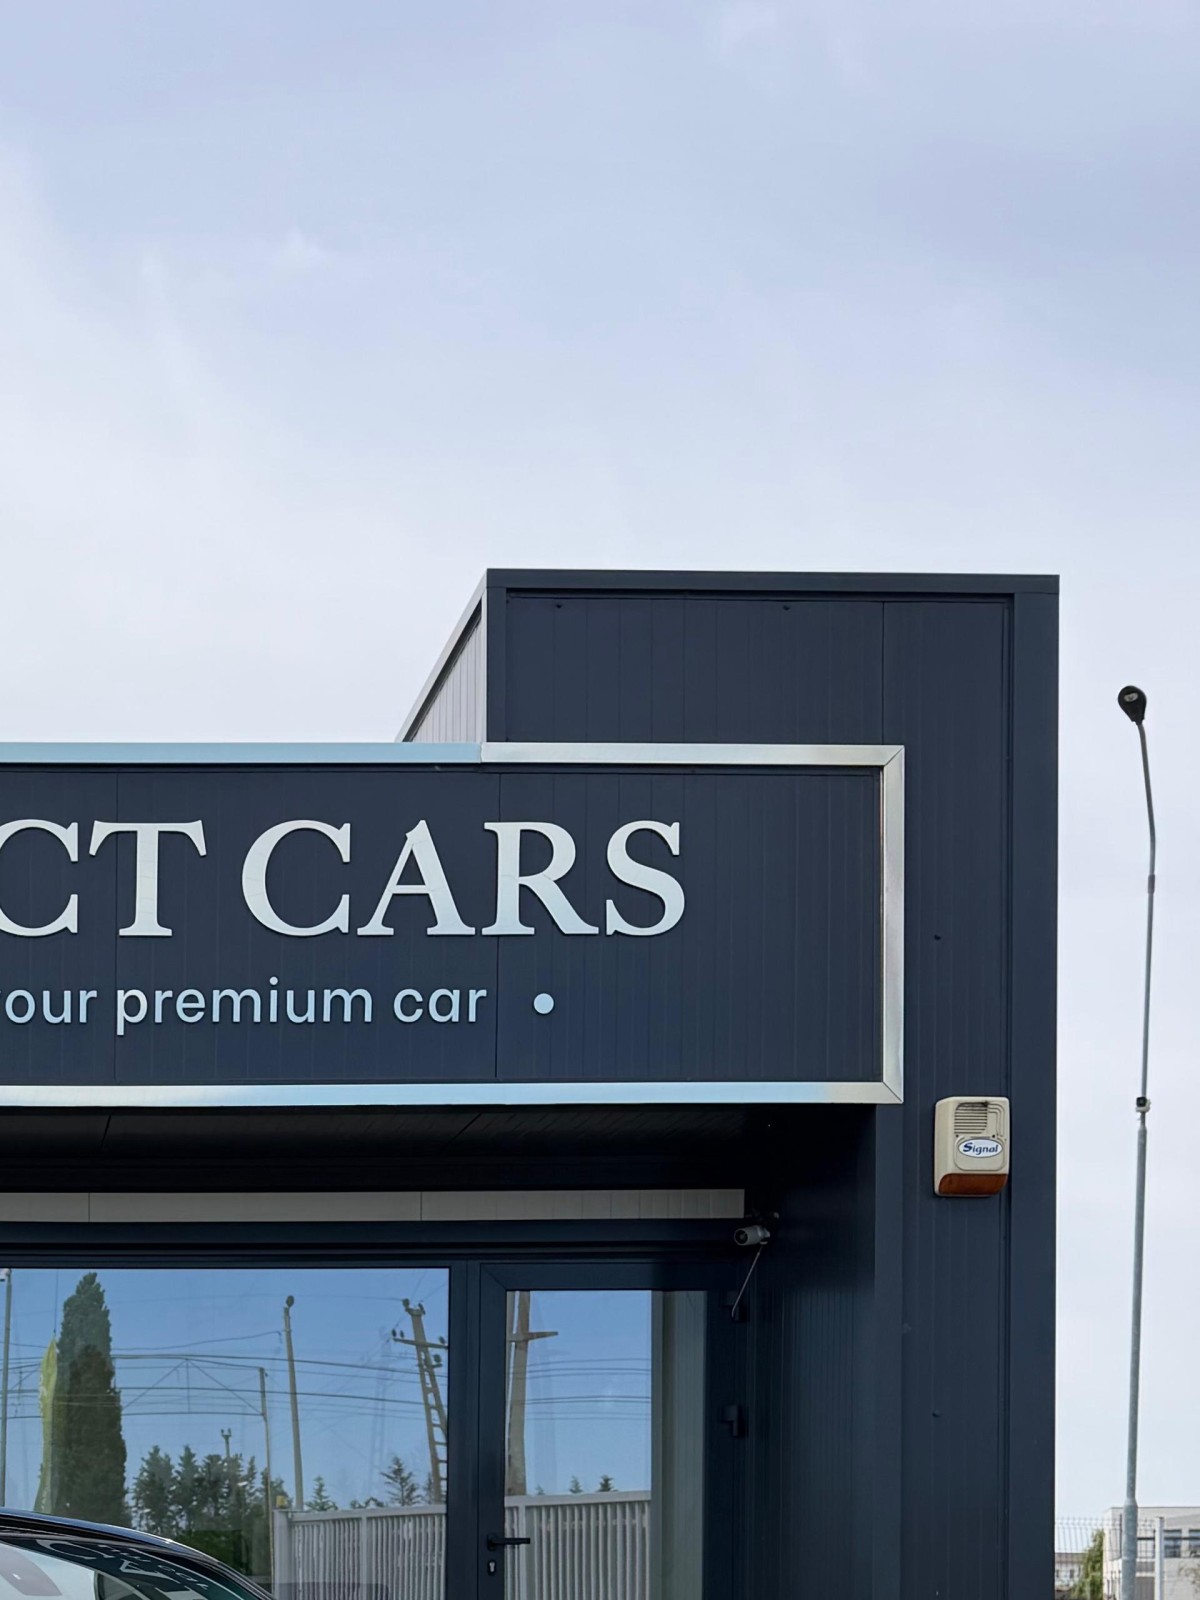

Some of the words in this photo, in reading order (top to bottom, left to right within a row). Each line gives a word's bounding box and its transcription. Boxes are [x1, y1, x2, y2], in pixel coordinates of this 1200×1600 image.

[241, 819, 685, 936] CARS
[116, 976, 373, 1035] premium
[393, 987, 487, 1022] car
[962, 1142, 999, 1156] Signal
